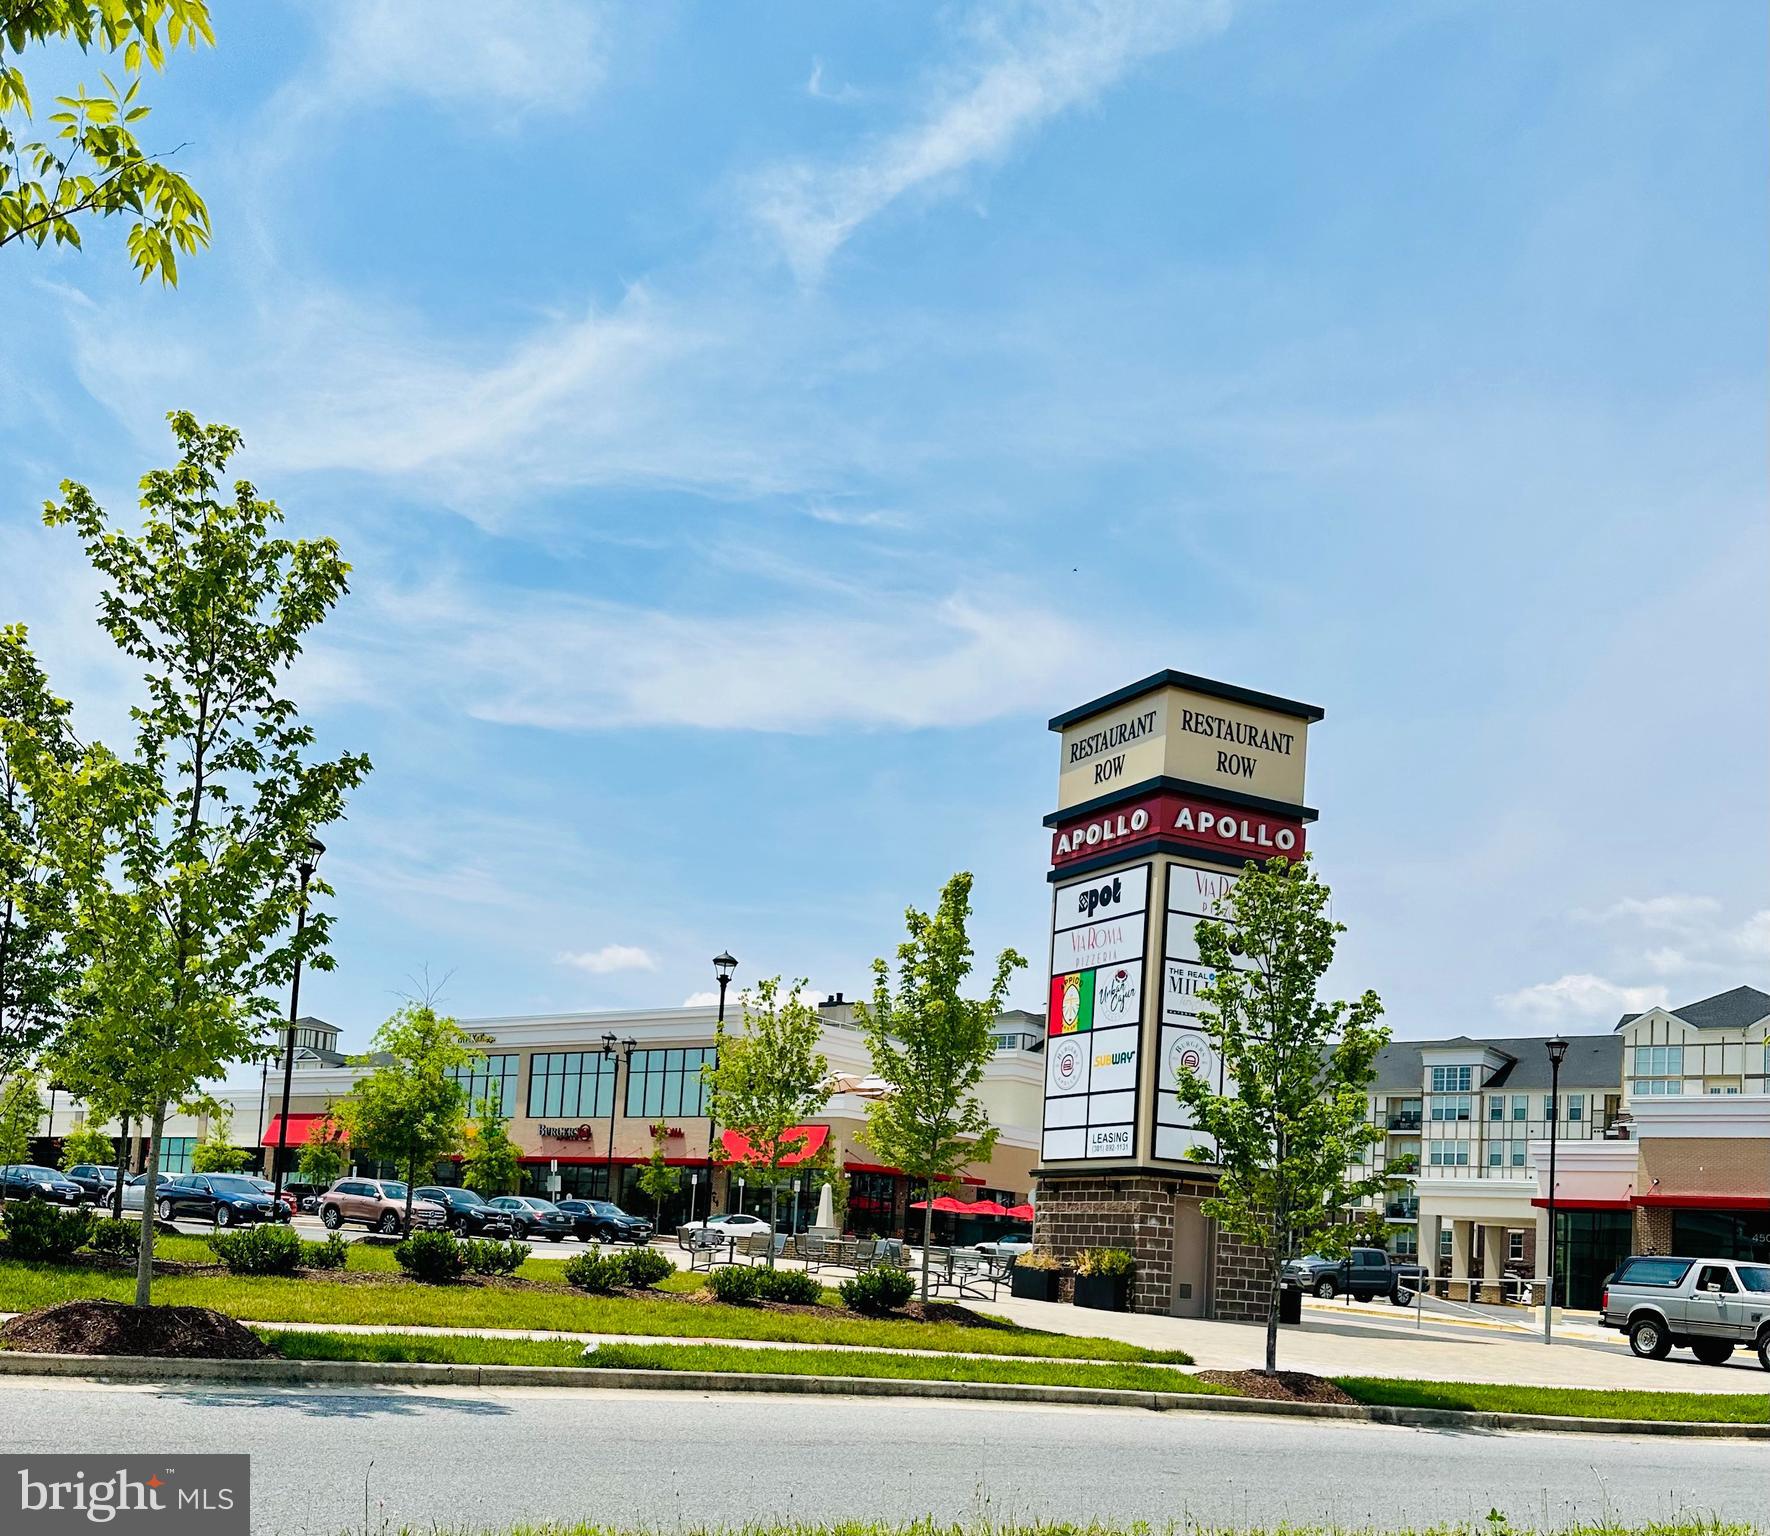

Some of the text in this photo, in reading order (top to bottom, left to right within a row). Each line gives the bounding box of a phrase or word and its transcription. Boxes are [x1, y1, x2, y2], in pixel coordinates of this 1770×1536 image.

[1070, 711, 1157, 763] RESTAURANT
[1181, 709, 1294, 755] RESTAURANT
[1094, 754, 1125, 784] ROW
[1216, 751, 1257, 779] ROW
[1056, 808, 1149, 855] APOLLO
[1174, 807, 1296, 850] APOLLO
[1078, 877, 1122, 918] spot
[1195, 872, 1216, 898] VIA
[1075, 949, 1117, 968] PIZZERIA
[1169, 967, 1208, 980] THE REAL
[1093, 1050, 1136, 1067] SUBWAY
[1092, 1131, 1129, 1144] LEASING
